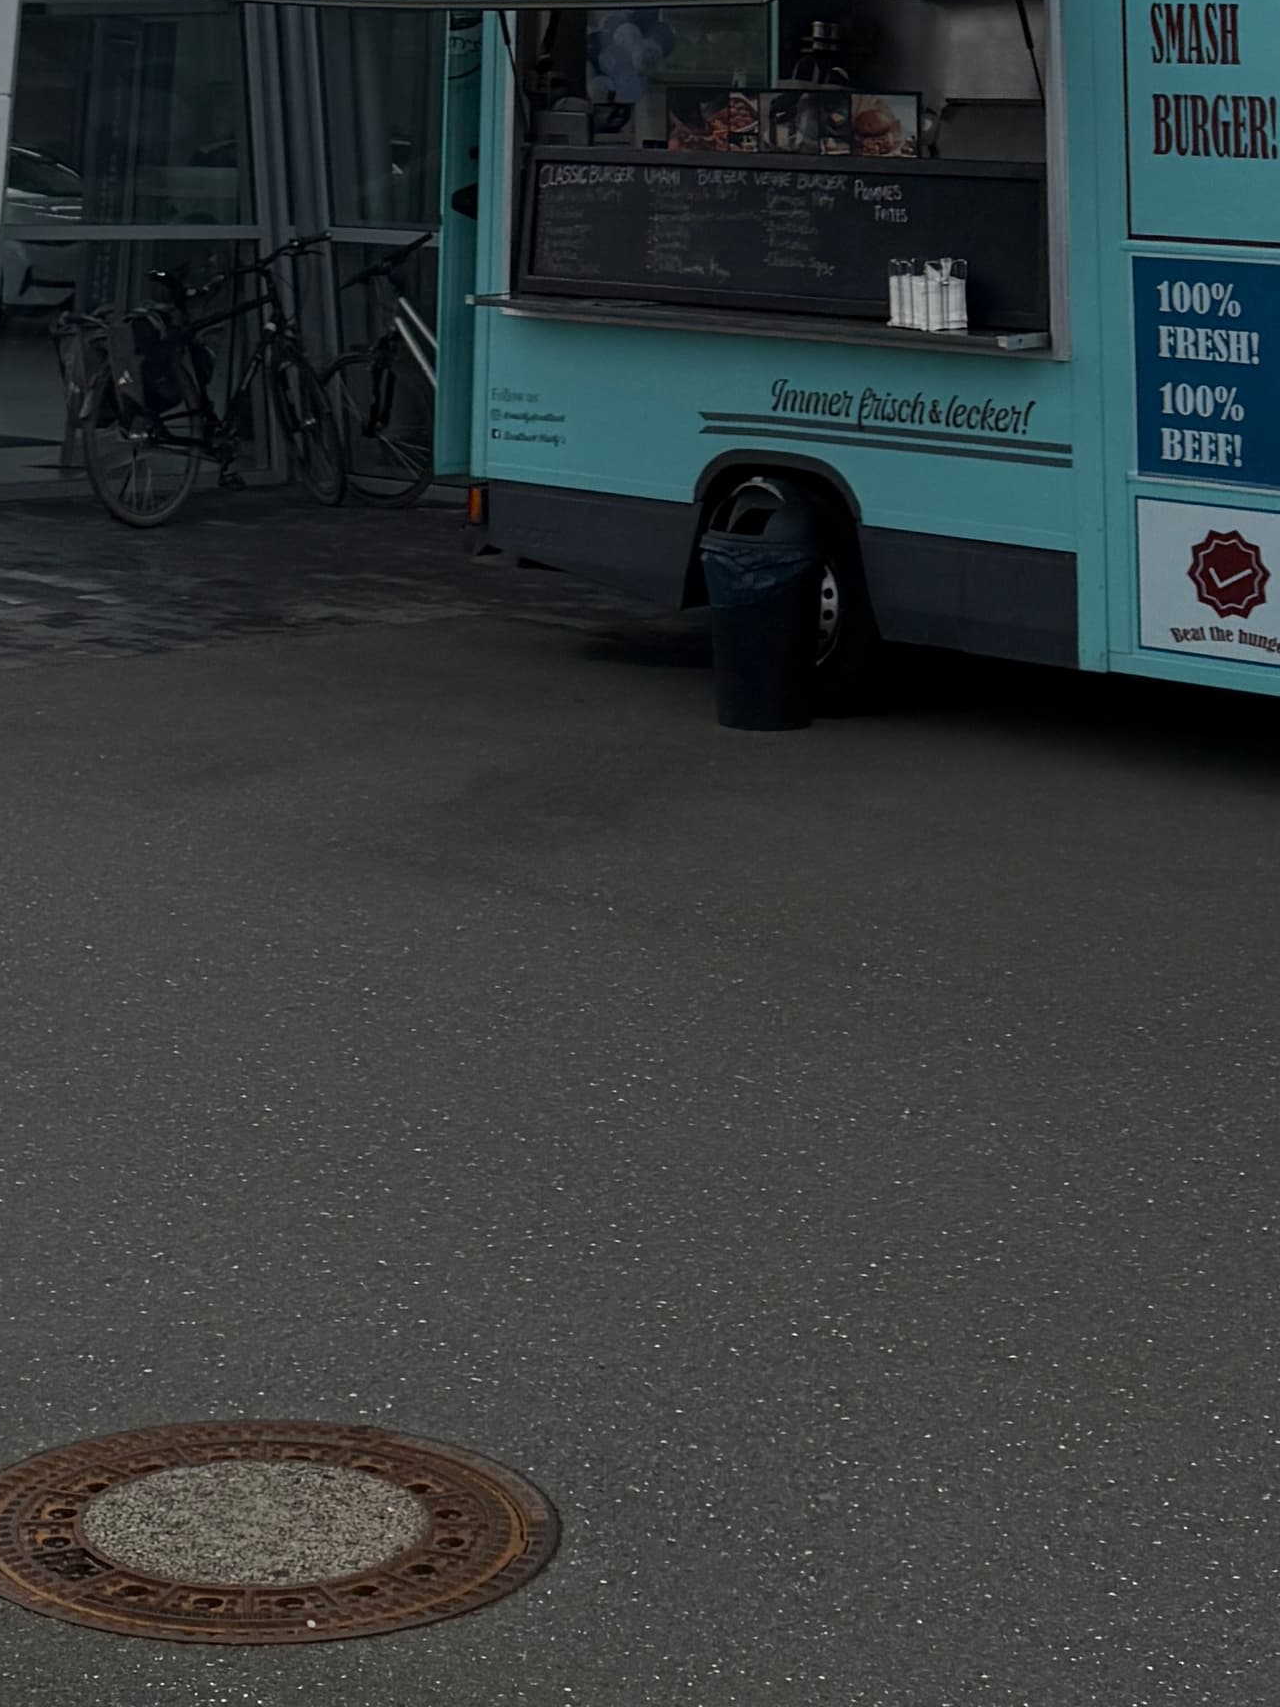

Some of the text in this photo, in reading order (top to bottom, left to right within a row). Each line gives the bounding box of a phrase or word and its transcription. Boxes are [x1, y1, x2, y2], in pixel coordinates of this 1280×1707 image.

[1150, 2, 1241, 65] SMASH
[1151, 93, 1278, 160] BURGER!
[539, 164, 636, 188] CLASSIC BURGER
[1155, 280, 1242, 319] 100%
[1157, 325, 1261, 366] FRESH!
[771, 378, 1037, 435] Immer frisch & lecker!
[1159, 382, 1246, 423] 100%
[1160, 428, 1244, 469] BEEF!
[1170, 626, 1206, 643] Beat
[1209, 626, 1234, 643] the
